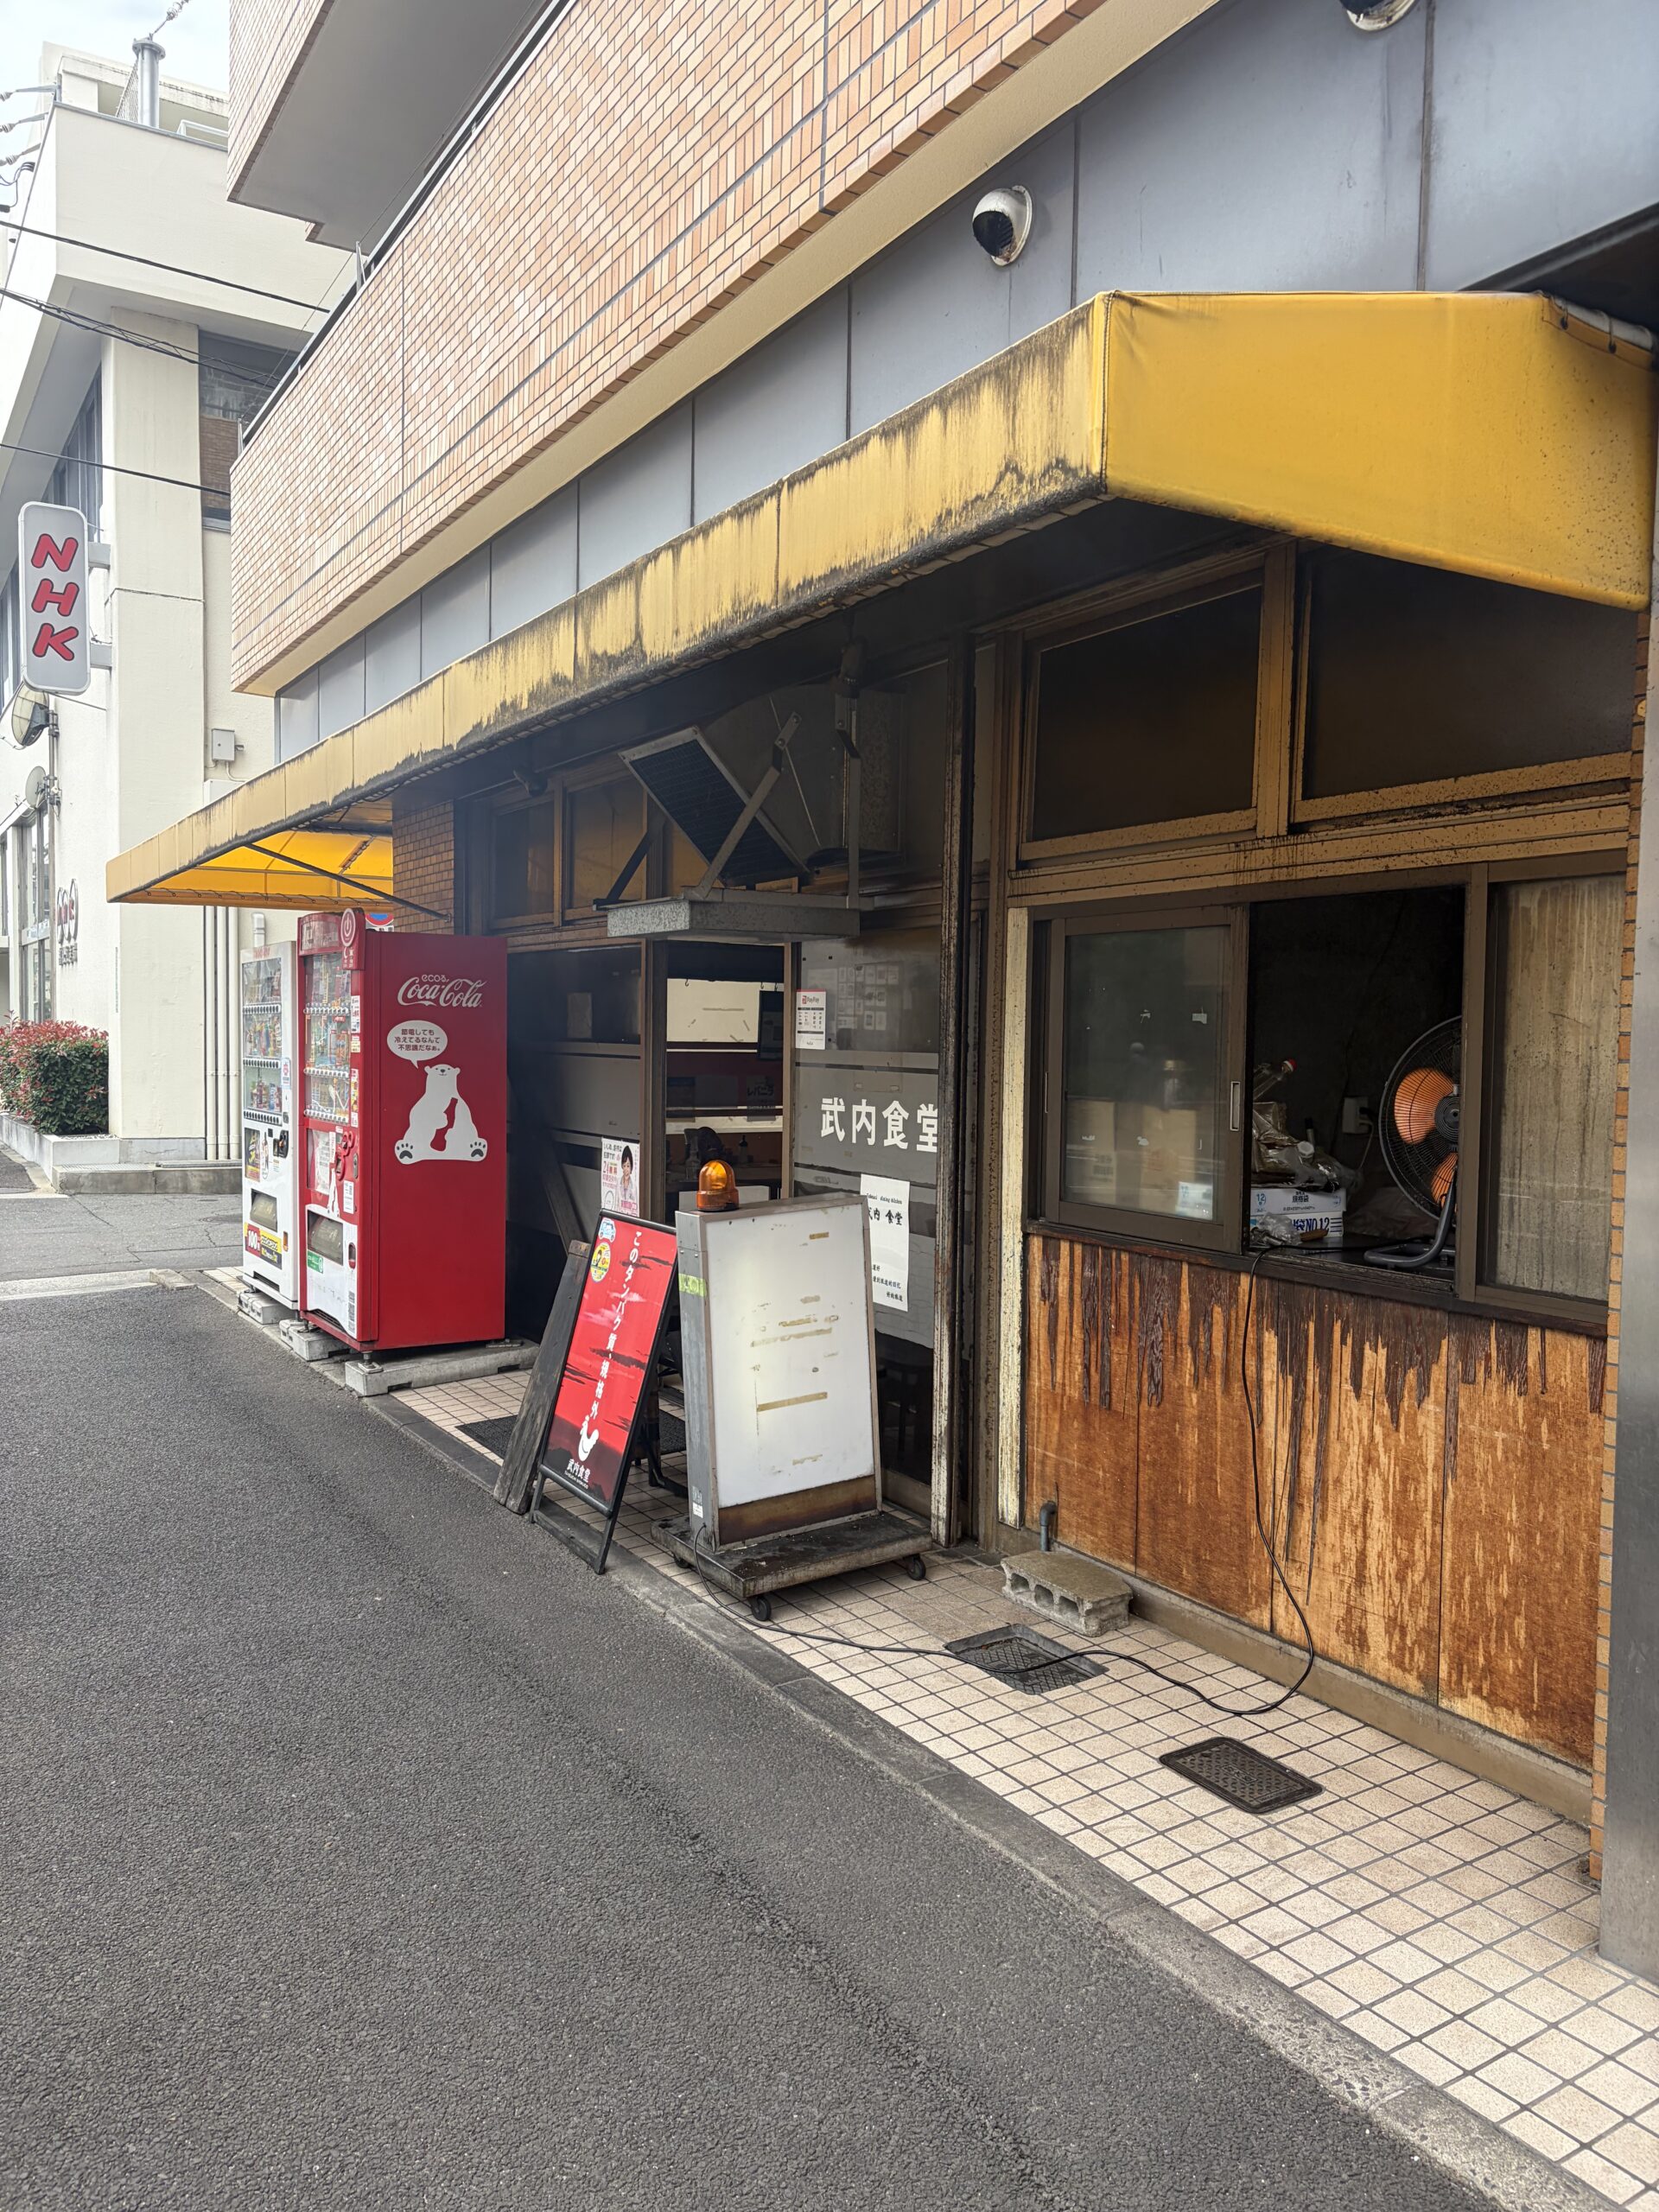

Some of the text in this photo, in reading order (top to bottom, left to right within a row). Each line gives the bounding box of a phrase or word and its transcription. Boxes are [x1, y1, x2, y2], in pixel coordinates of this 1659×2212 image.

[31, 533, 79, 662] NHK
[397, 976, 487, 1007] Coca-Cola
[821, 1096, 938, 1153] 武内食堂
[566, 1458, 591, 1484] 武内食堂
